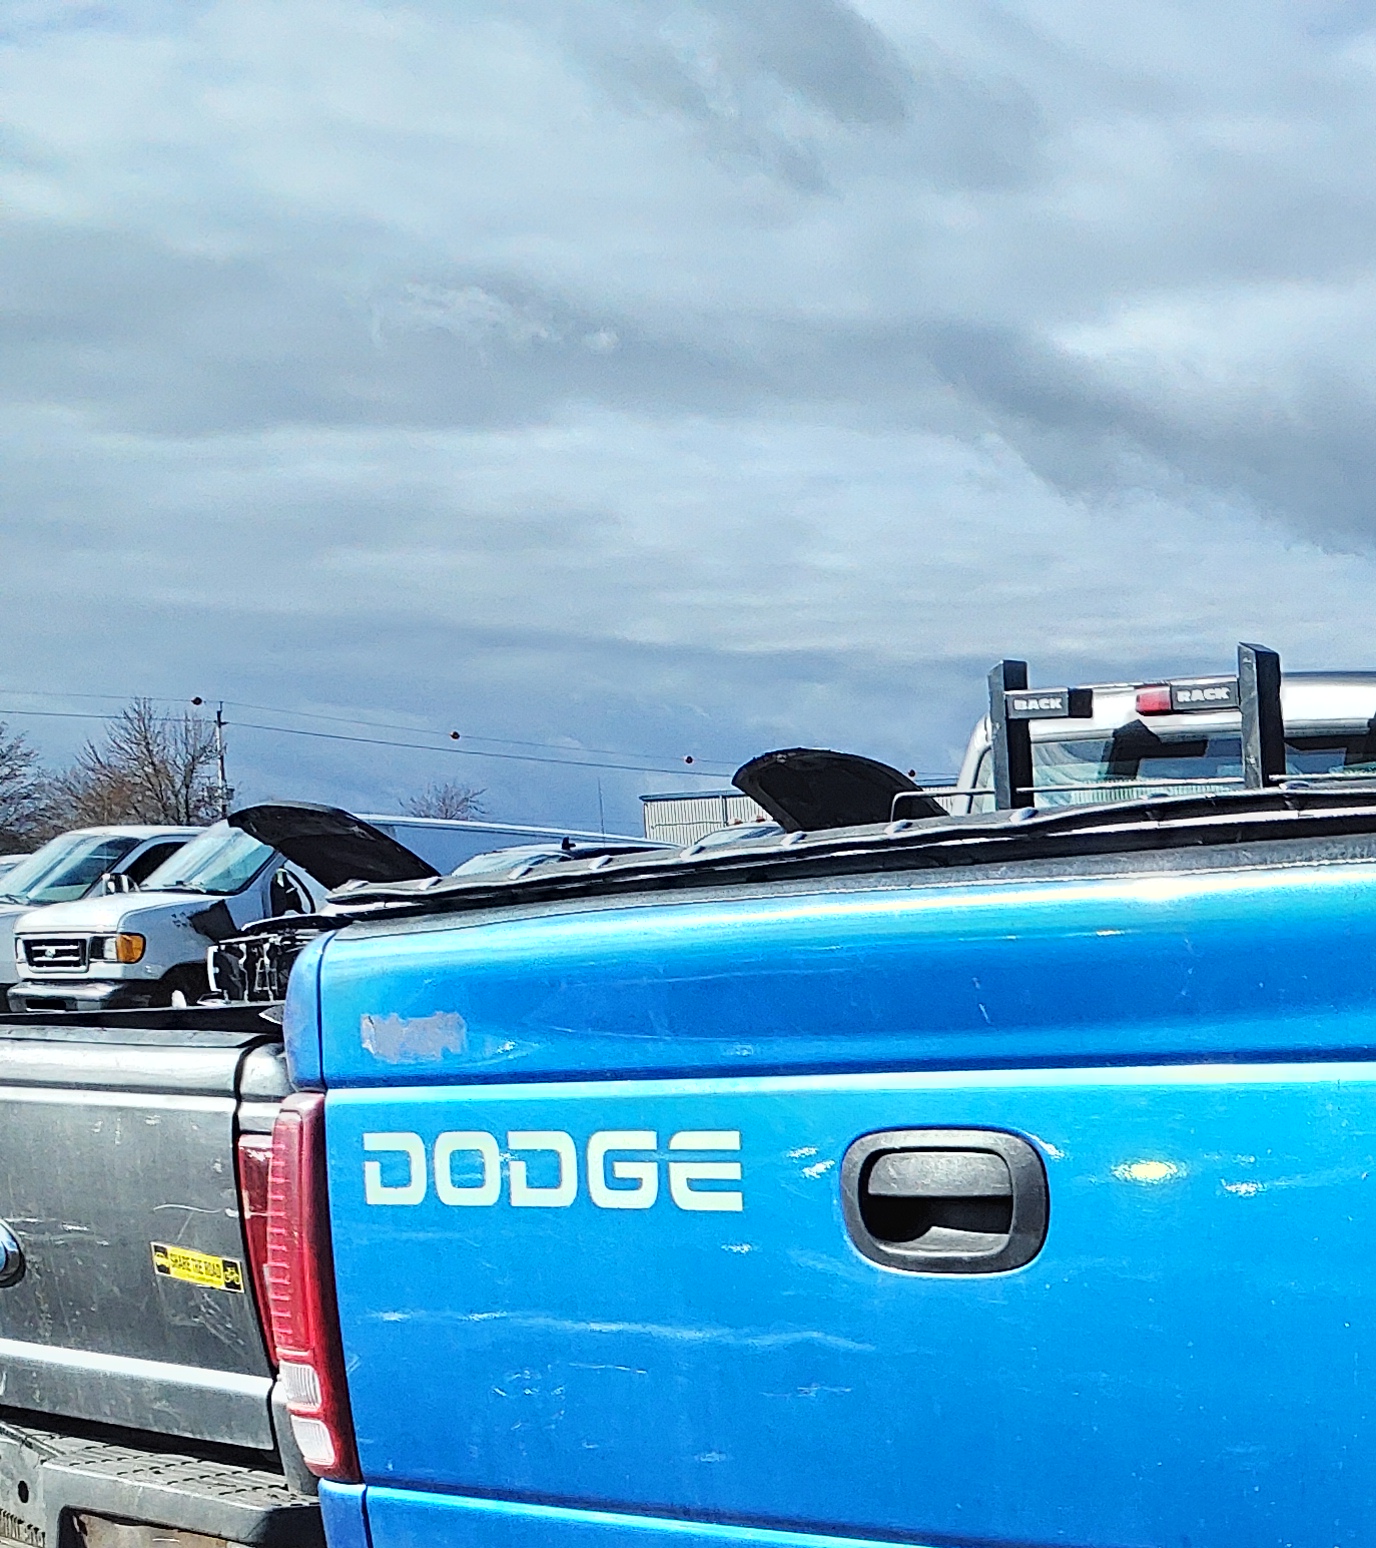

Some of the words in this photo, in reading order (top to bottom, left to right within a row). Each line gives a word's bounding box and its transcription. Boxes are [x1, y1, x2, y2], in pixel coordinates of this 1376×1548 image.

[1013, 696, 1063, 711] BACK
[1176, 686, 1231, 703] RACK
[363, 1131, 743, 1212] DODGE
